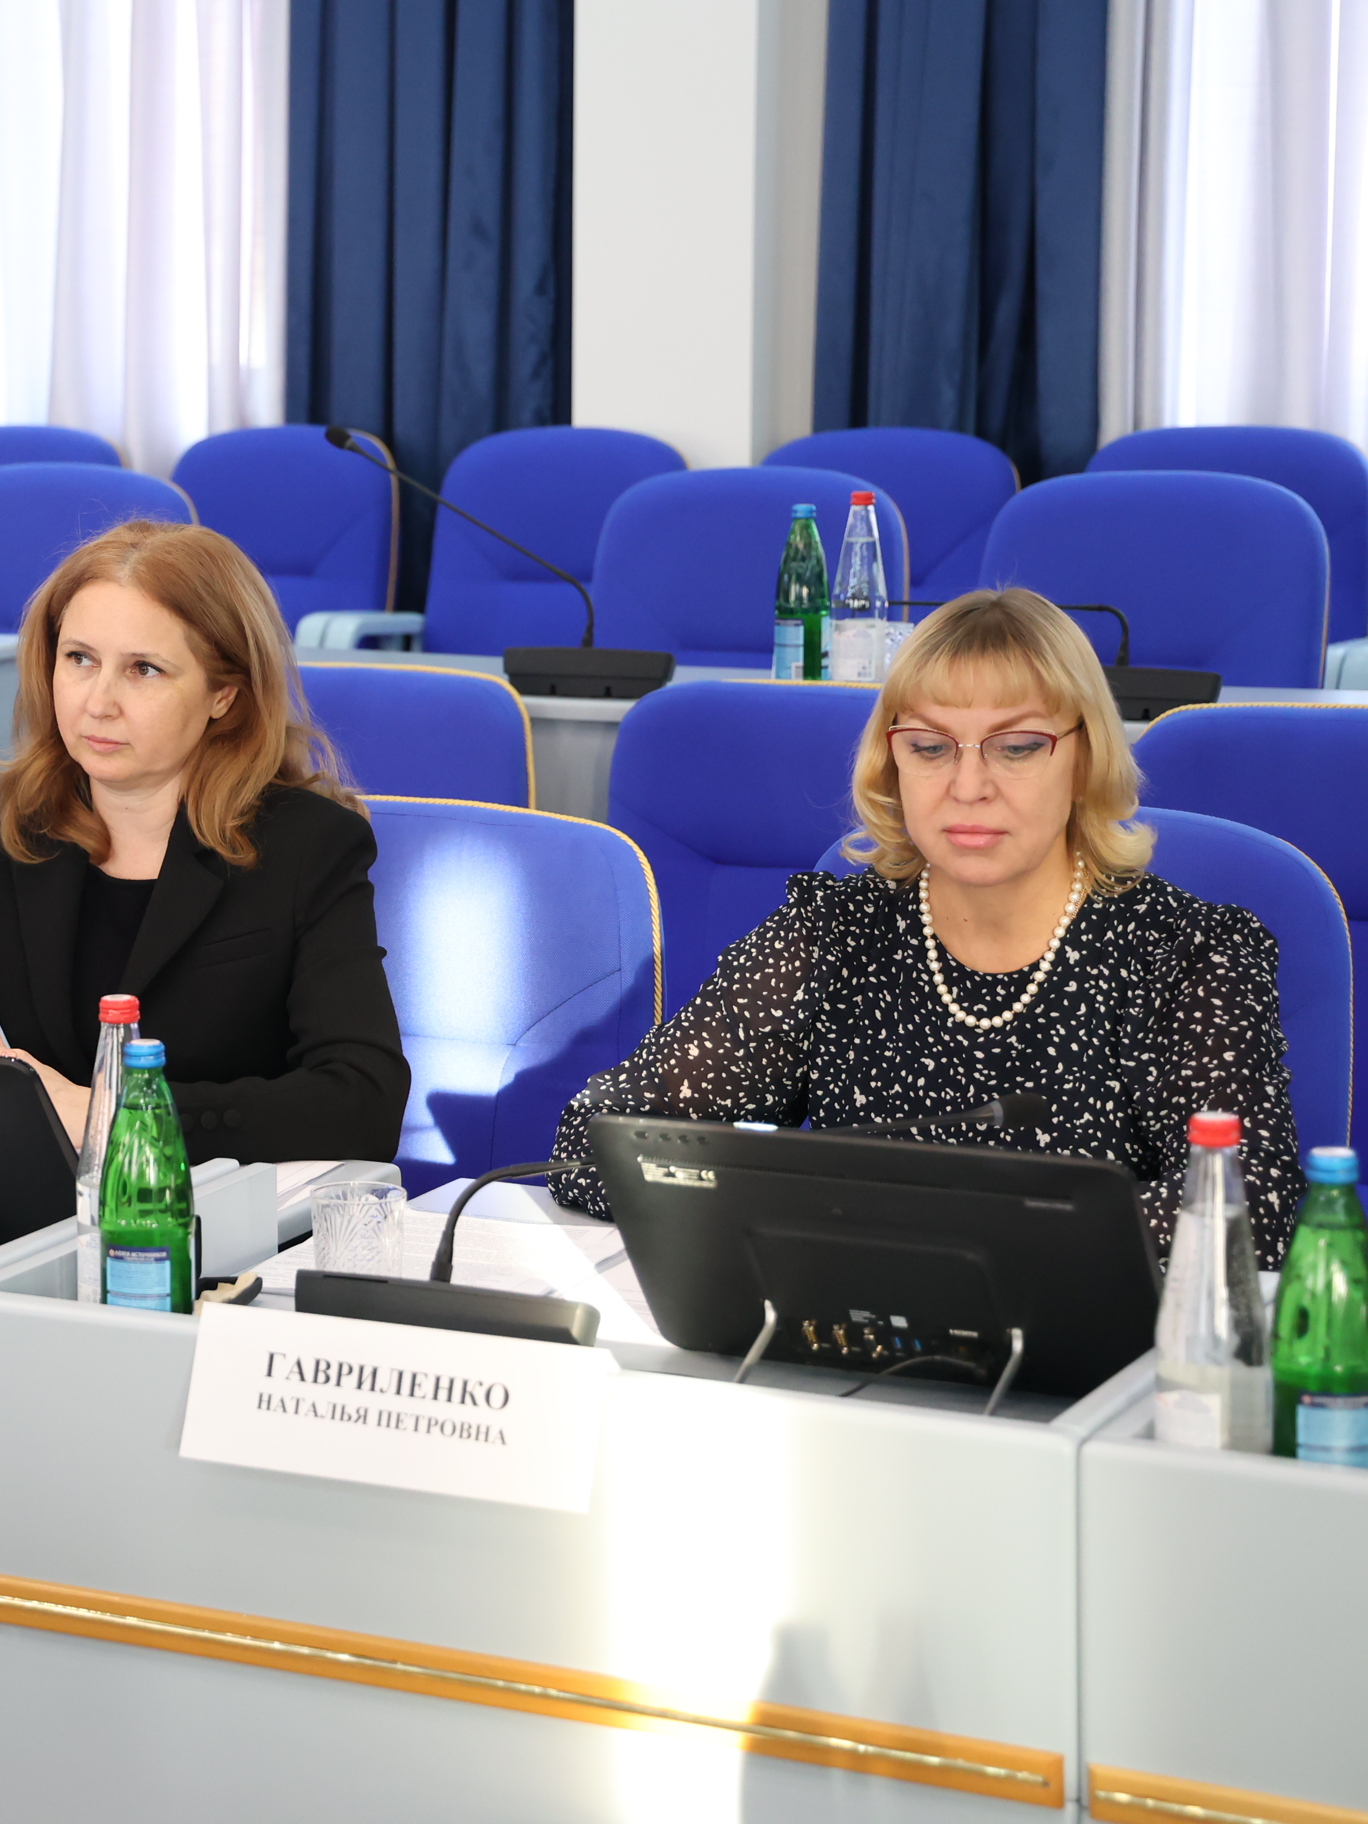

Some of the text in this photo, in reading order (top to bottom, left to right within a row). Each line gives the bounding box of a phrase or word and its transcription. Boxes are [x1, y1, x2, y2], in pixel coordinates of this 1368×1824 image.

[265, 1351, 510, 1410] ГАВРИЛЕНКО
[256, 1392, 507, 1446] НАТАЛЬЯ ПЕТРОВНА
